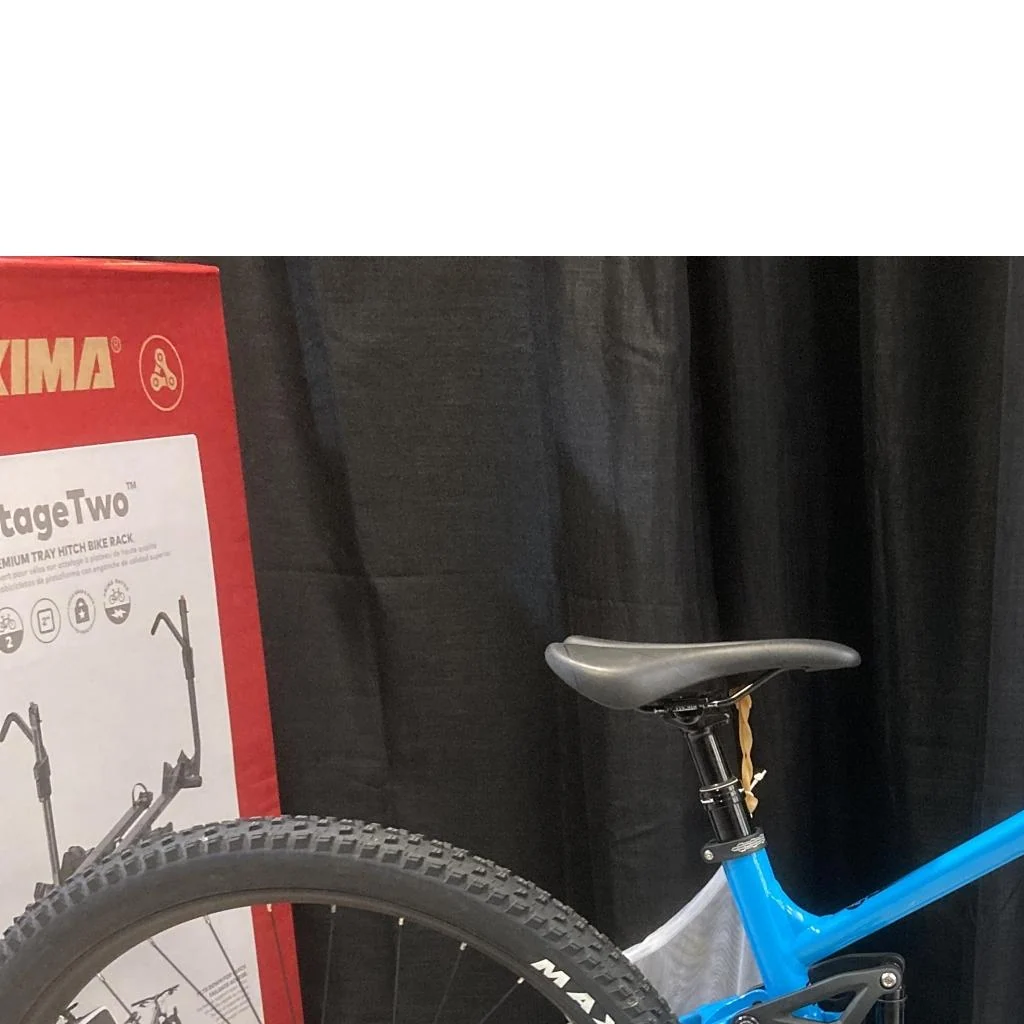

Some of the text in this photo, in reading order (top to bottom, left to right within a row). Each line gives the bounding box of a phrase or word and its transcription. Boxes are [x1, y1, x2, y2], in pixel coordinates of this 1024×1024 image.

[31, 547, 56, 562] TRAY
[58, 541, 87, 557] HITCH
[88, 537, 109, 551] BIKE
[109, 532, 134, 547] RACK
